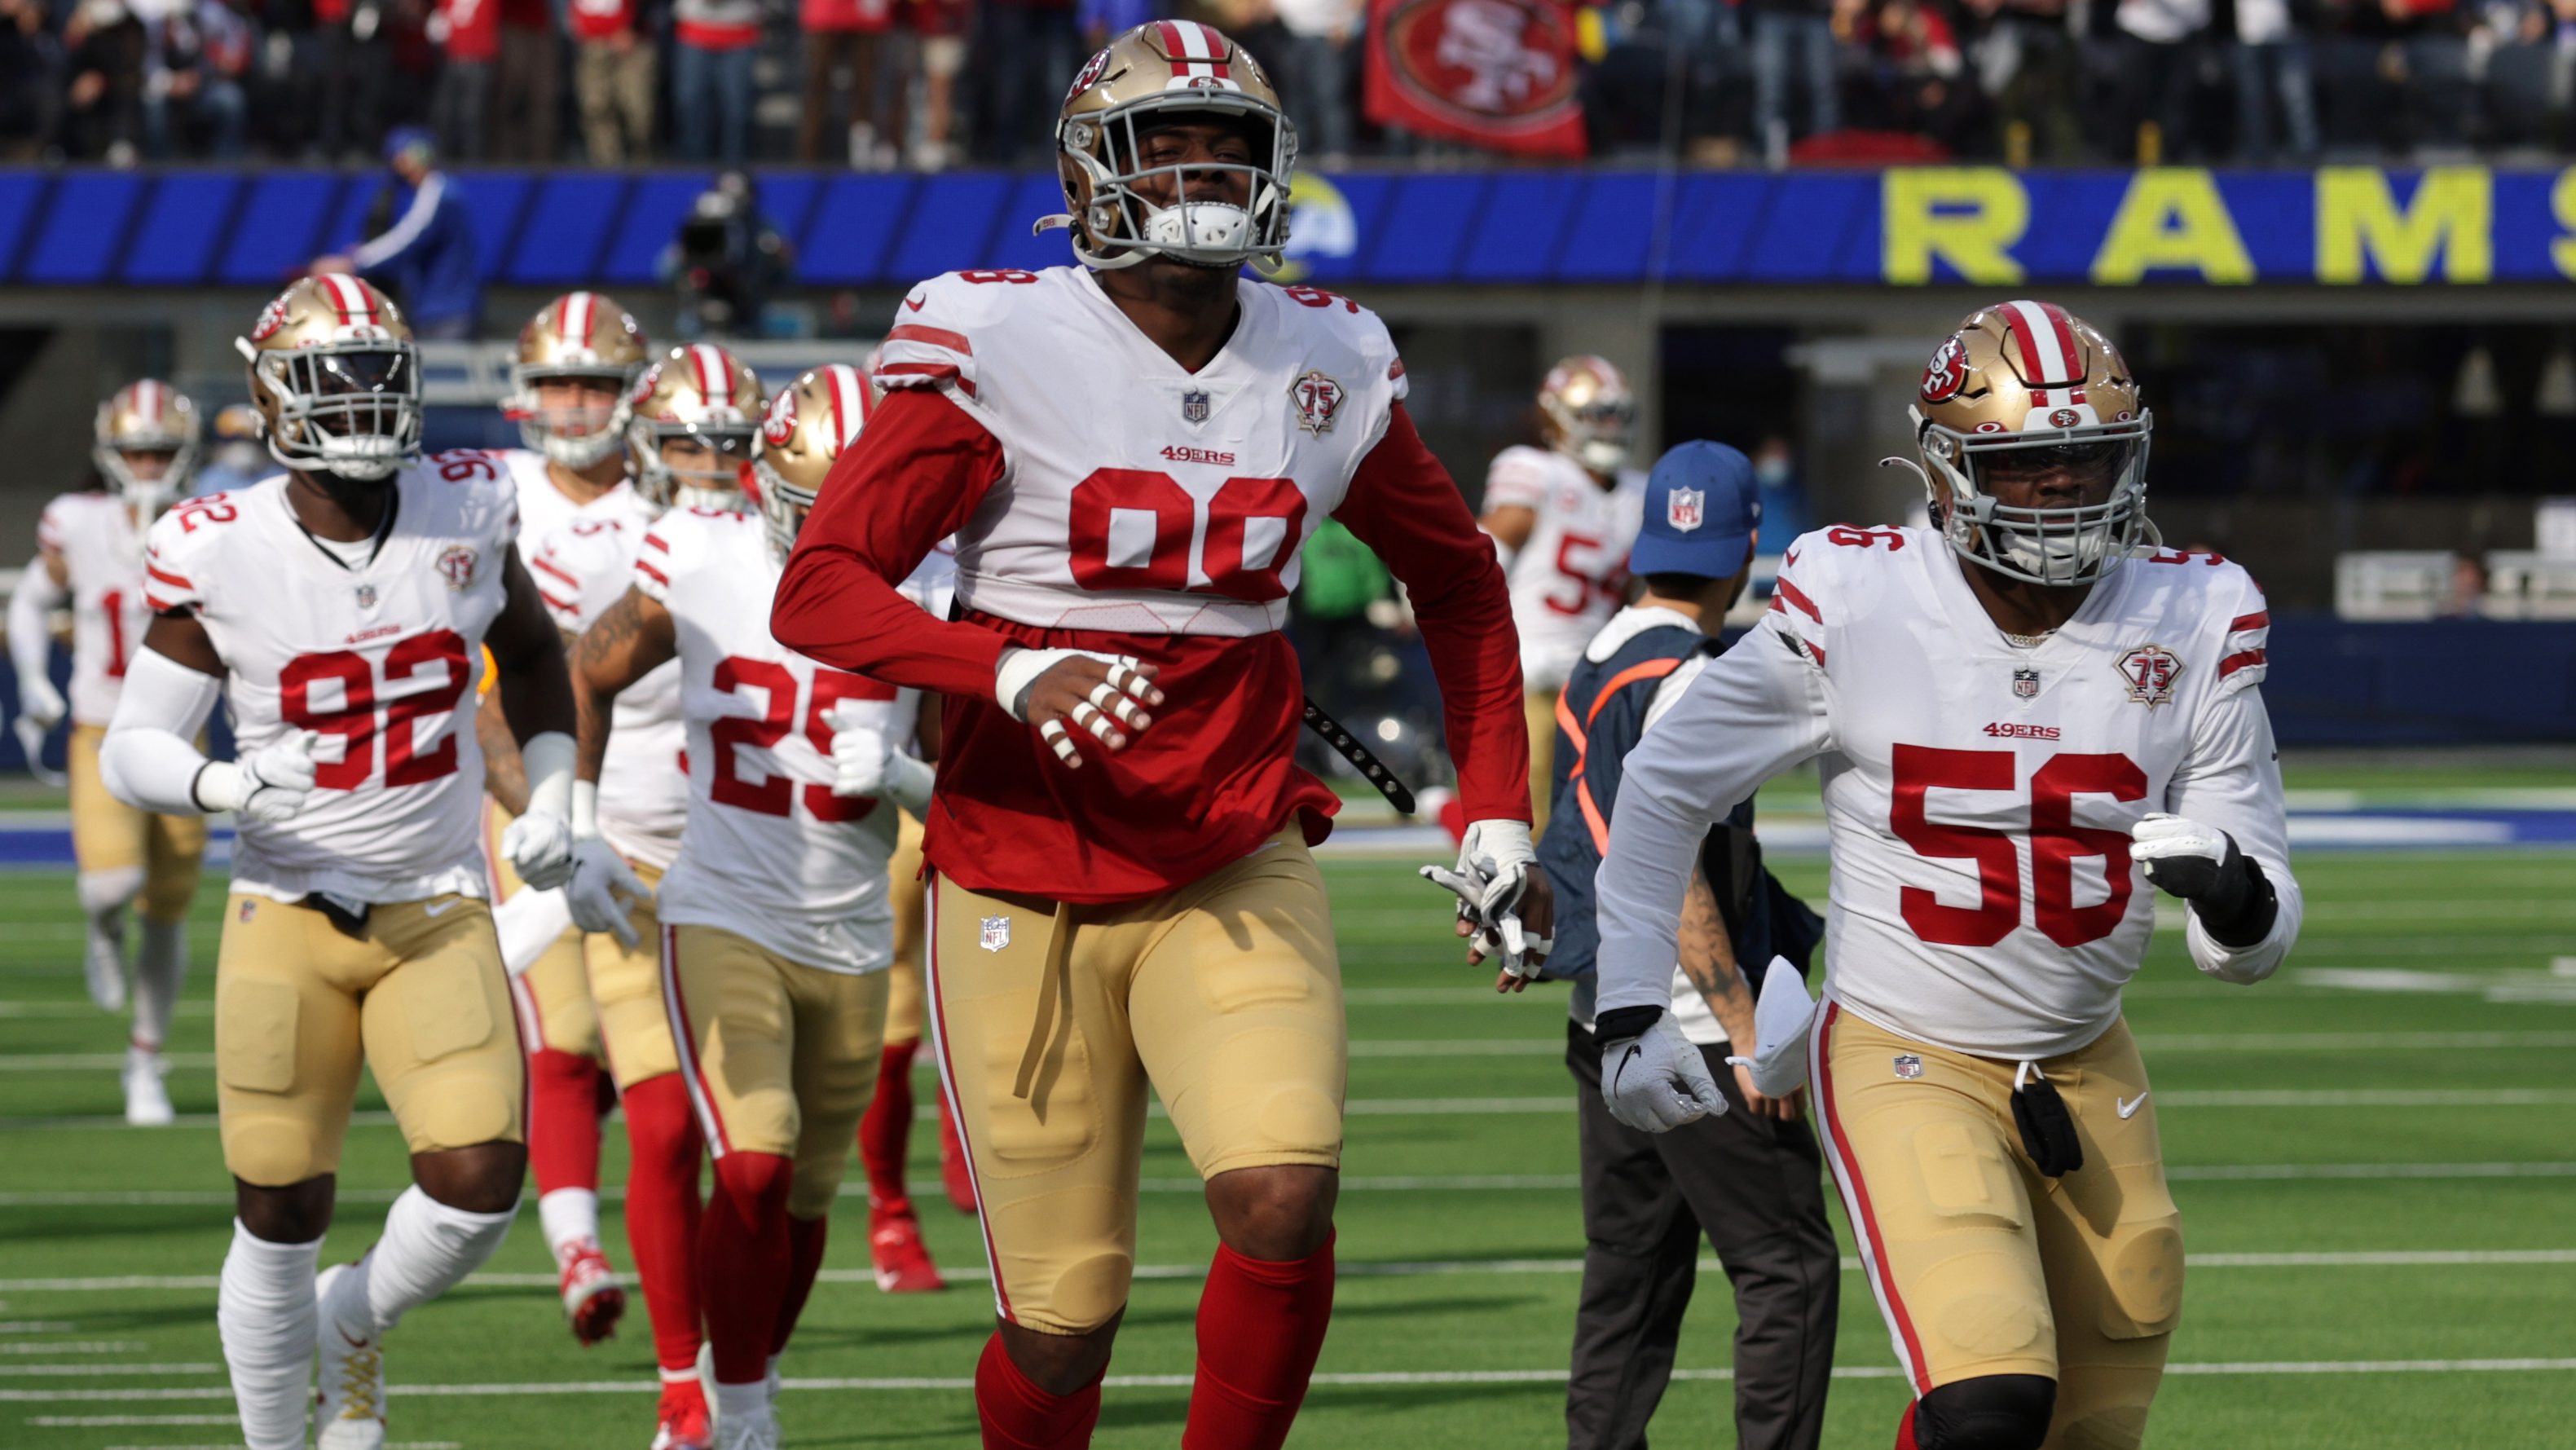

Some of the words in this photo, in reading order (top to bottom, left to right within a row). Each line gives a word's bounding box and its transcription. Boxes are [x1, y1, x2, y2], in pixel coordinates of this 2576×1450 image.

[1042, 217, 1055, 227] 98
[1882, 167, 2576, 284] RAM
[1187, 403, 1206, 418] NFL
[1301, 384, 1334, 418] 75
[1160, 445, 1235, 467] 49ERS
[2132, 657, 2170, 690] 75
[2015, 681, 2036, 694] NFL
[279, 628, 470, 792] 92
[708, 654, 900, 823] 25
[1982, 722, 2061, 742] 49ERS
[1889, 743, 2147, 947] 56
[986, 931, 1006, 945] NFL
